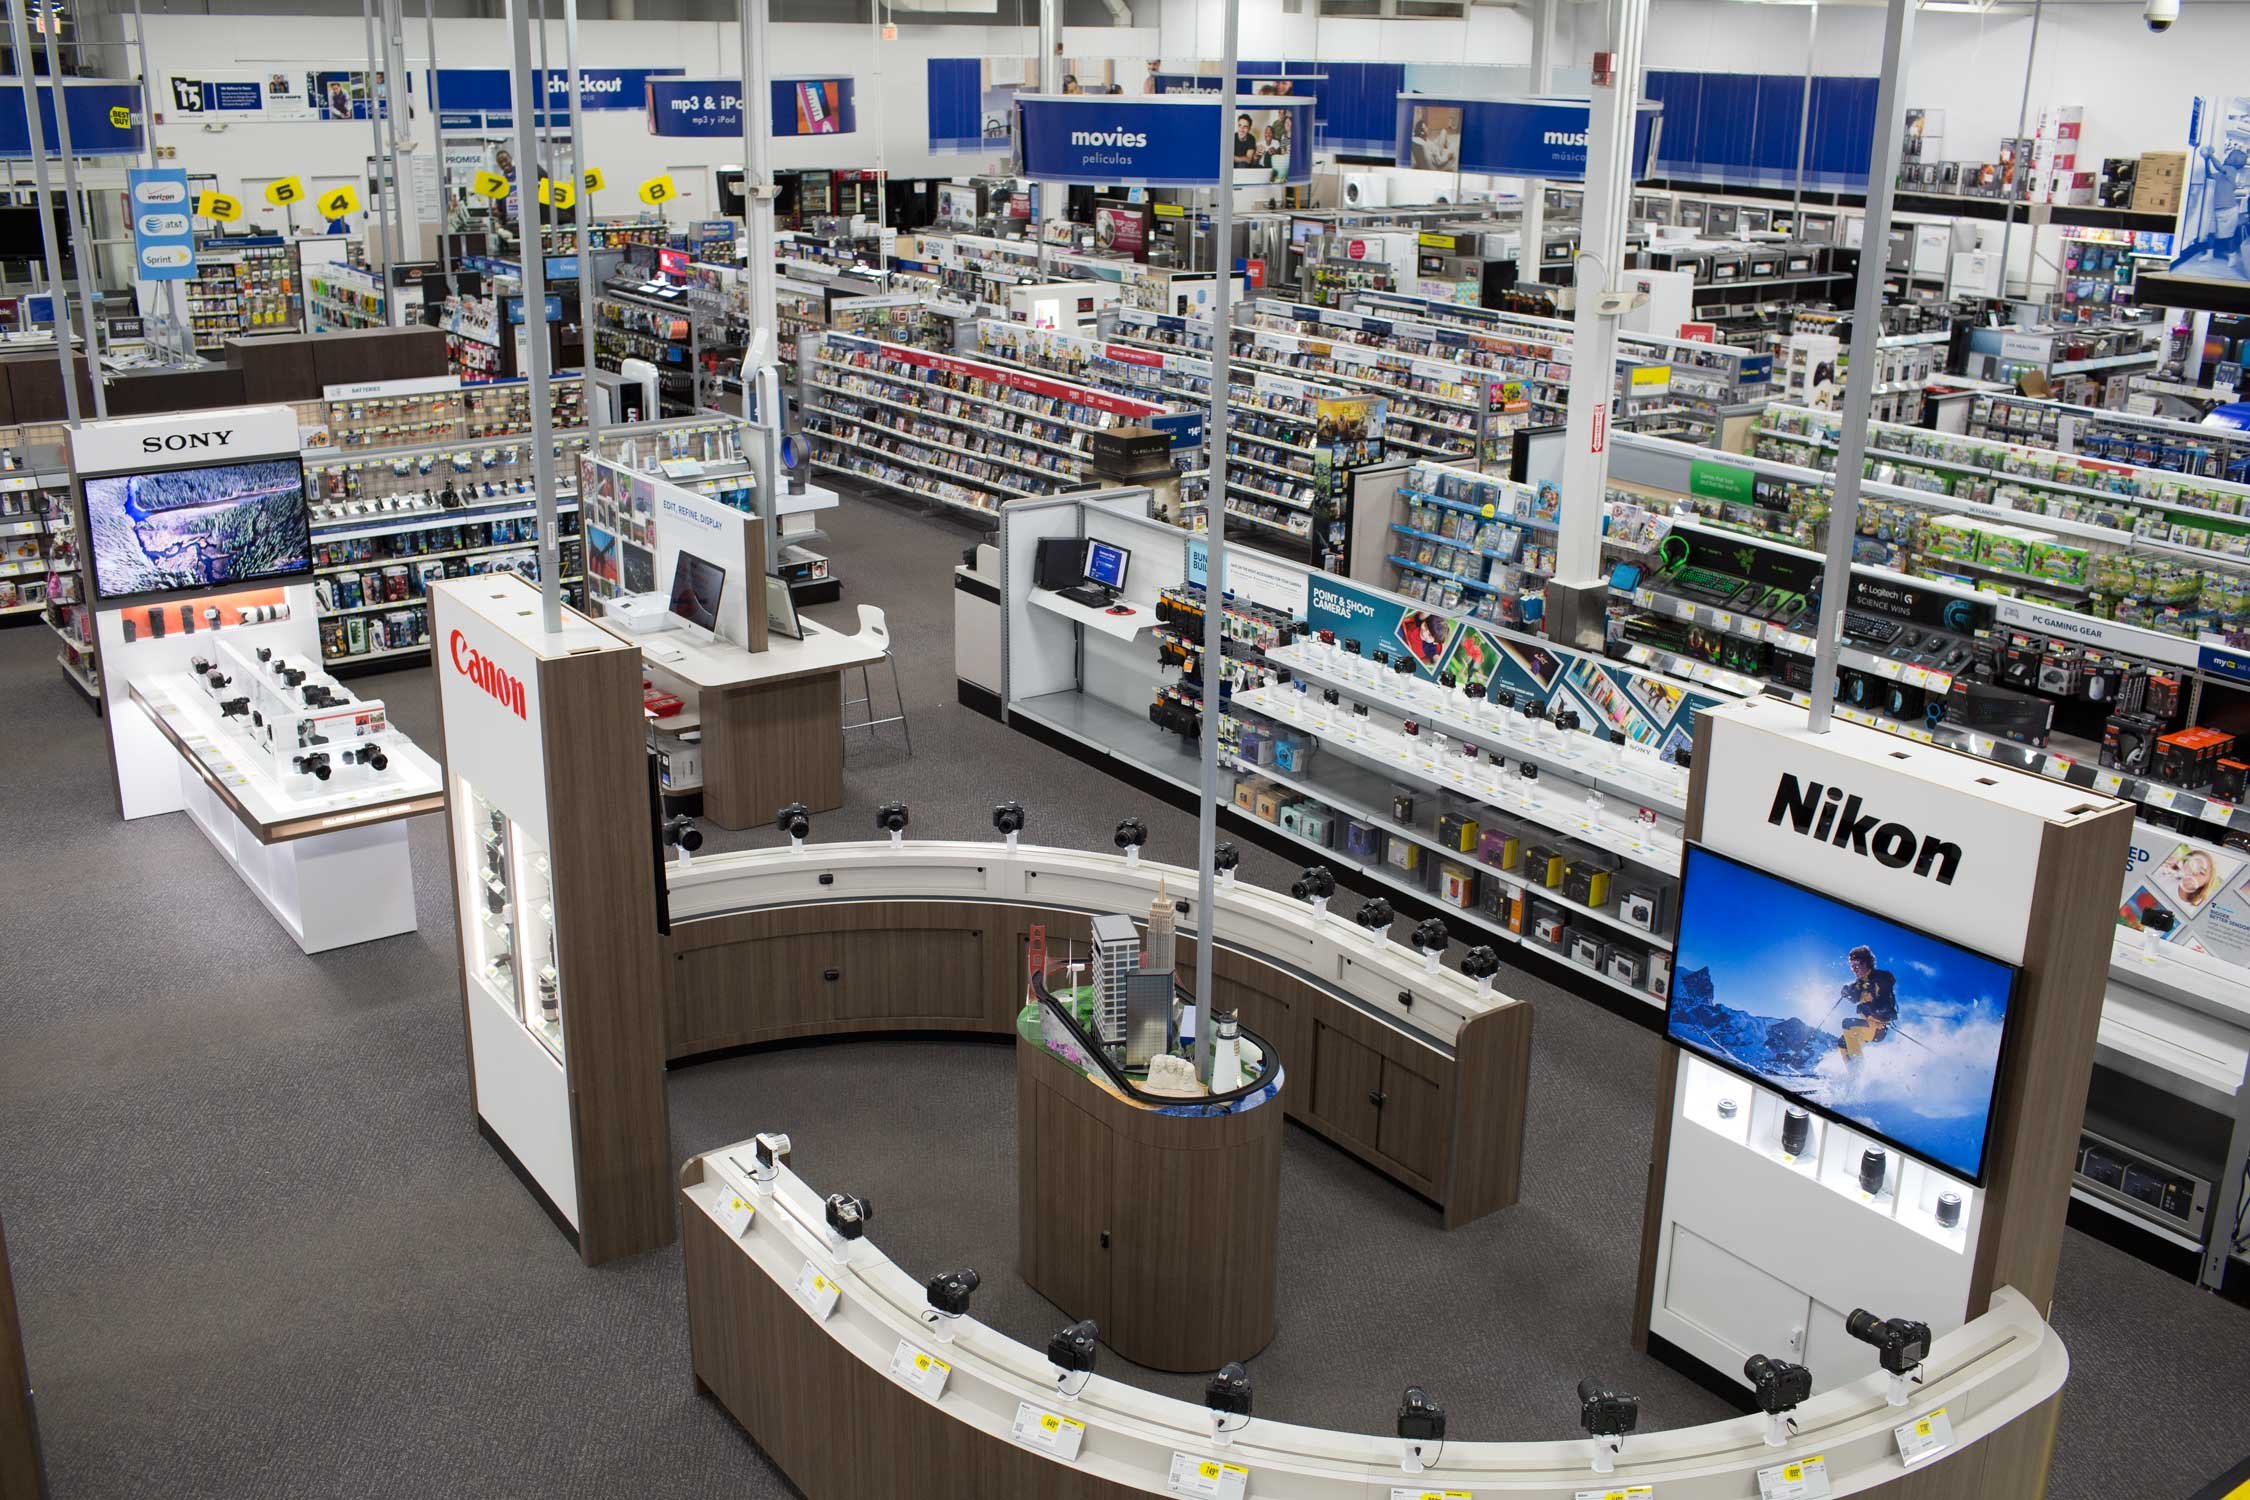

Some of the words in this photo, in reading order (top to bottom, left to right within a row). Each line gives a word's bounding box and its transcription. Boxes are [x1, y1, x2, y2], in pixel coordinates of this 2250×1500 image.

[671, 96, 699, 113] mp3
[703, 96, 716, 110] &
[721, 95, 743, 110] iPo
[112, 110, 130, 118] BEST
[114, 118, 129, 126] BUY
[1071, 126, 1148, 148] movies
[1544, 128, 1590, 146] musi
[276, 184, 295, 201] 5
[488, 178, 503, 193] 7
[649, 184, 666, 200] 8
[212, 199, 232, 217] 2
[330, 195, 349, 211] 4
[146, 256, 173, 265] Sprint
[142, 430, 233, 453] SONY
[700, 514, 722, 531] DISPLAY
[1869, 585, 1899, 600] Logitech
[1313, 588, 1338, 604] POINT
[1338, 597, 1346, 607] &
[1346, 599, 1375, 617] SHOOT
[1313, 598, 1352, 619] CAMERAS
[1856, 596, 1889, 610] SCIENCE
[1890, 604, 1911, 616] WINS
[2032, 615, 2044, 624] PC
[2044, 619, 2079, 633] GAMING
[2080, 627, 2103, 638] GEAR
[450, 628, 527, 721] Canon
[1767, 771, 1963, 886] Nikon
